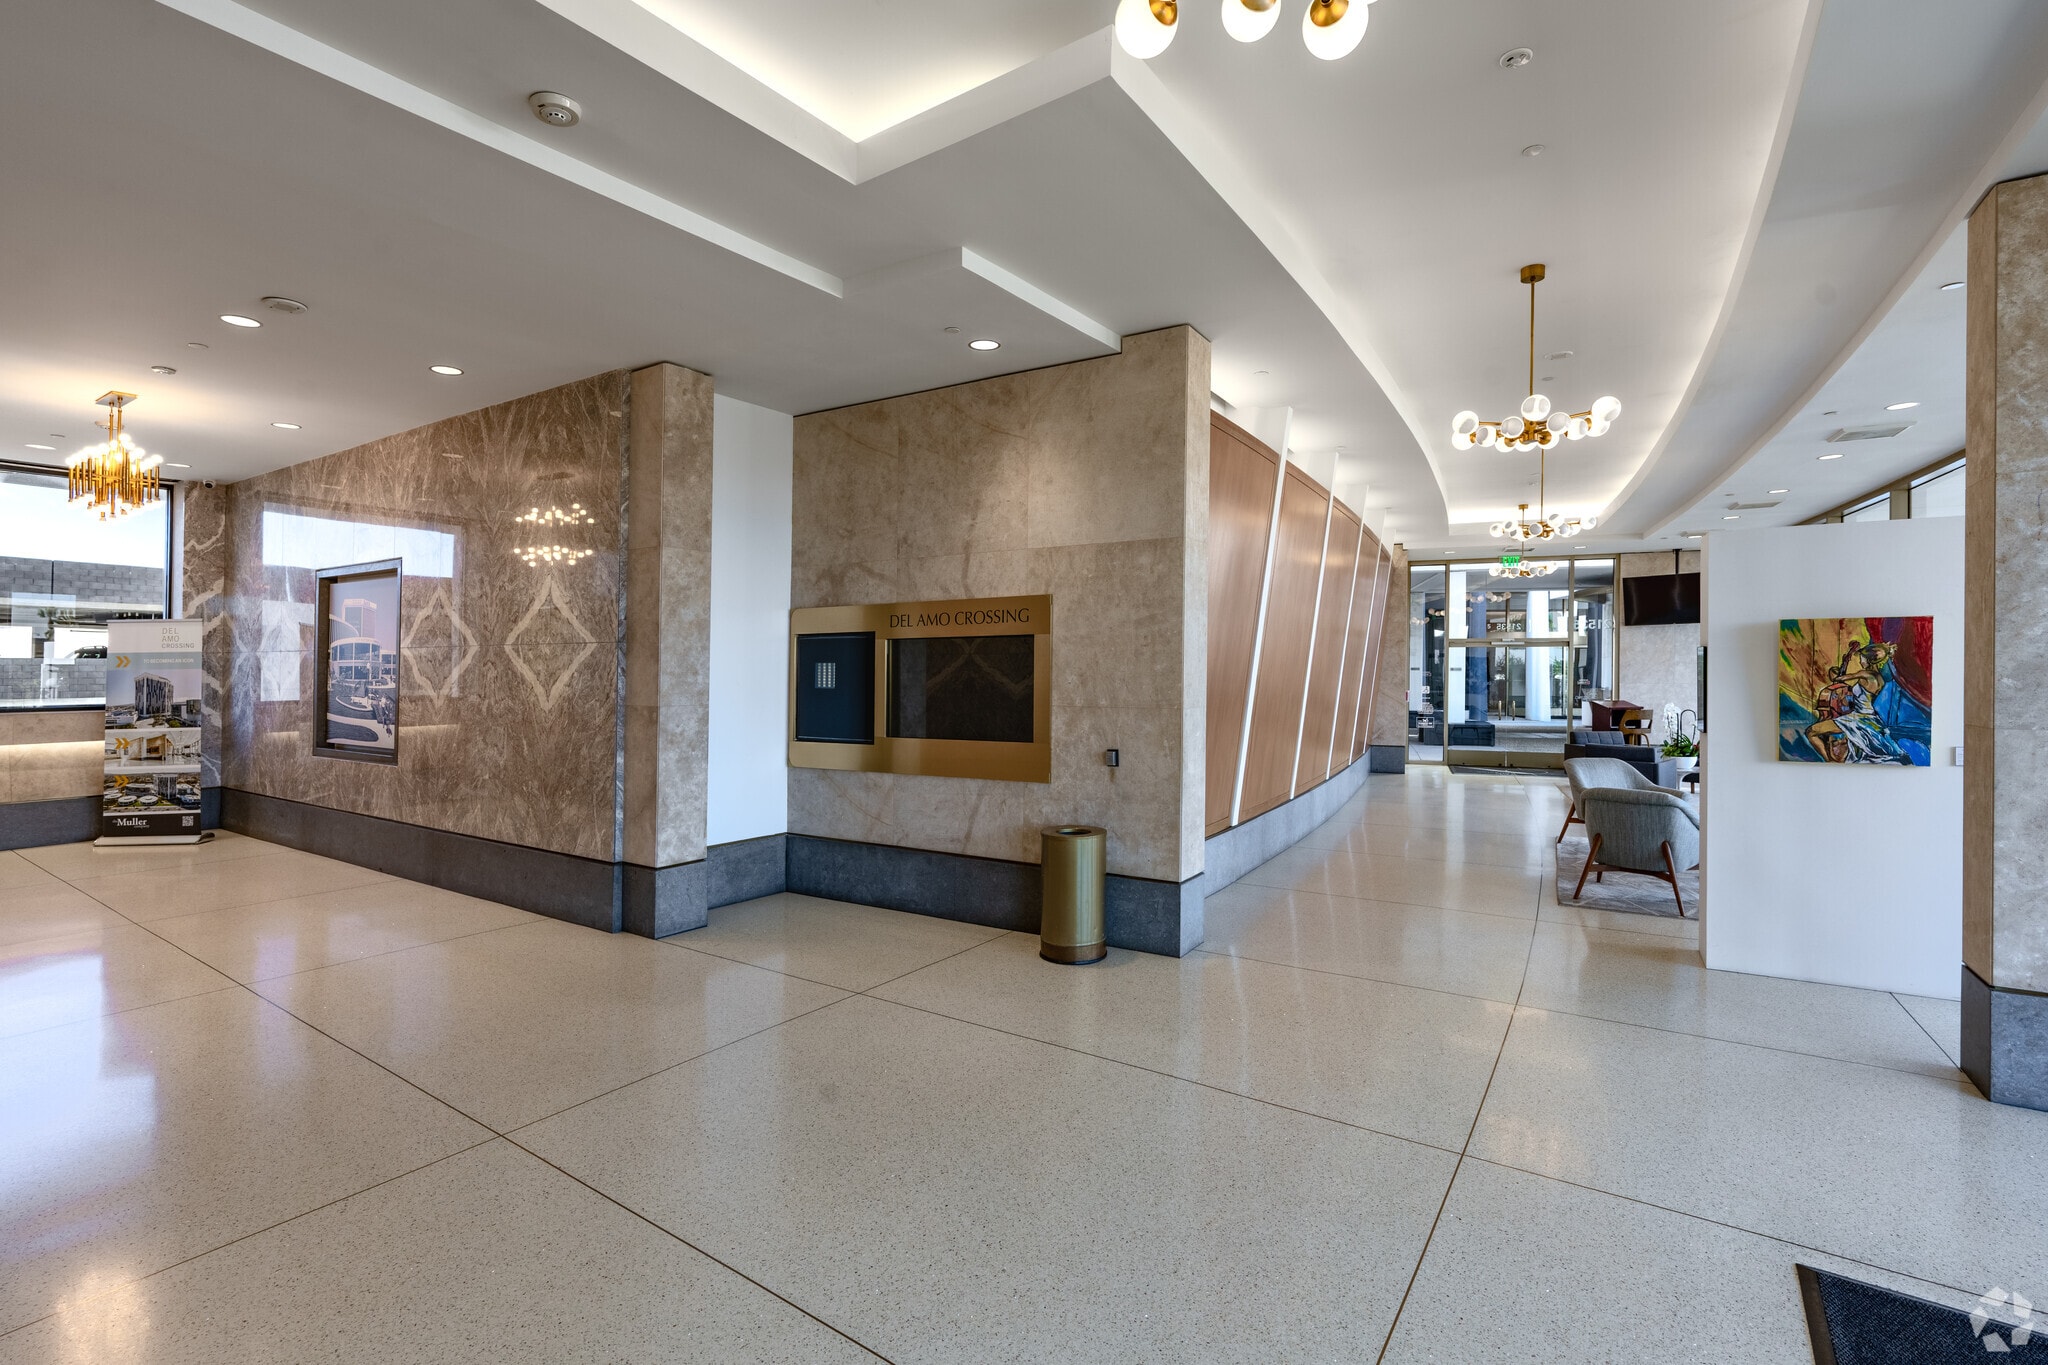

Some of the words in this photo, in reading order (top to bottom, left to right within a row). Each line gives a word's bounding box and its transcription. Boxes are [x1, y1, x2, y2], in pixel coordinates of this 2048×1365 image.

[1502, 555, 1520, 567] EXIT
[890, 614, 914, 628] DEL
[916, 612, 951, 627] AMO
[954, 608, 1030, 626] CROSSING
[162, 627, 179, 635] DEL
[116, 817, 148, 826] Muller
